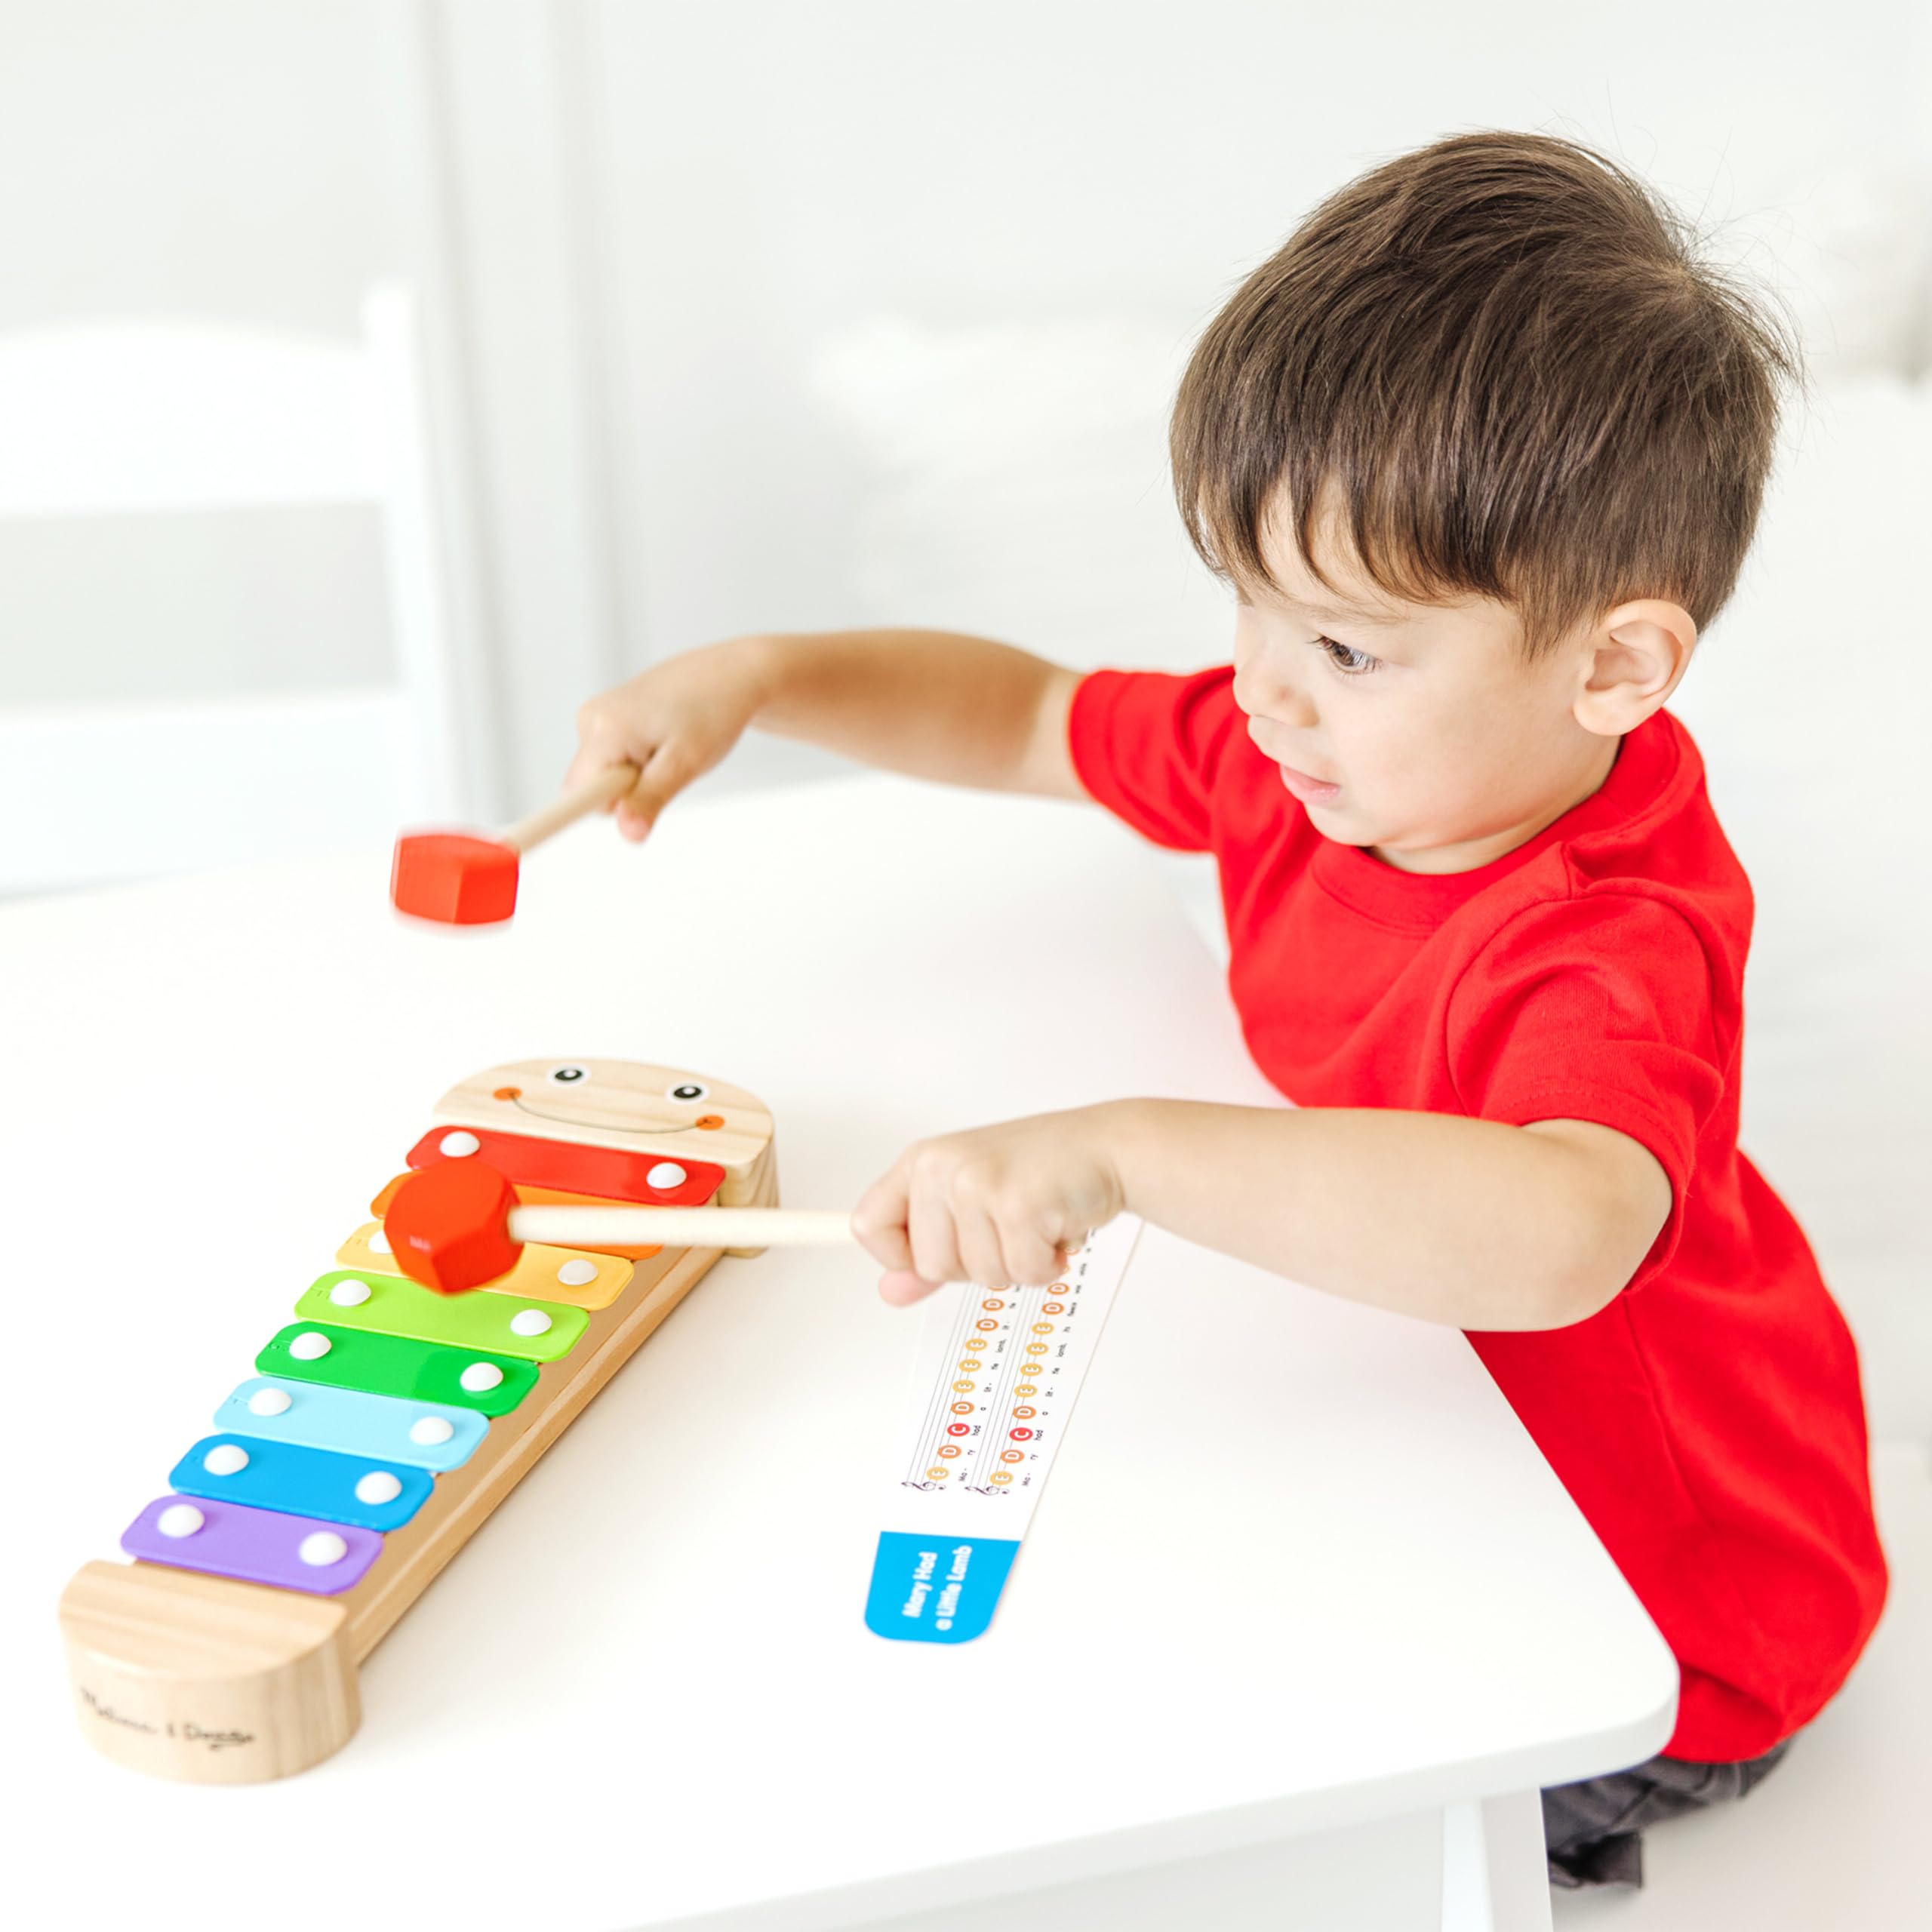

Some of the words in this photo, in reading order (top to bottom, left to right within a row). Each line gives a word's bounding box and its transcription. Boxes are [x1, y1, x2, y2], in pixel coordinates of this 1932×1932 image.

[912, 1551, 938, 1581] Had
[946, 1545, 973, 1582] Lamb
[902, 1581, 933, 1618] Mary
[935, 1583, 963, 1617] Little
[935, 1617, 953, 1631] a
